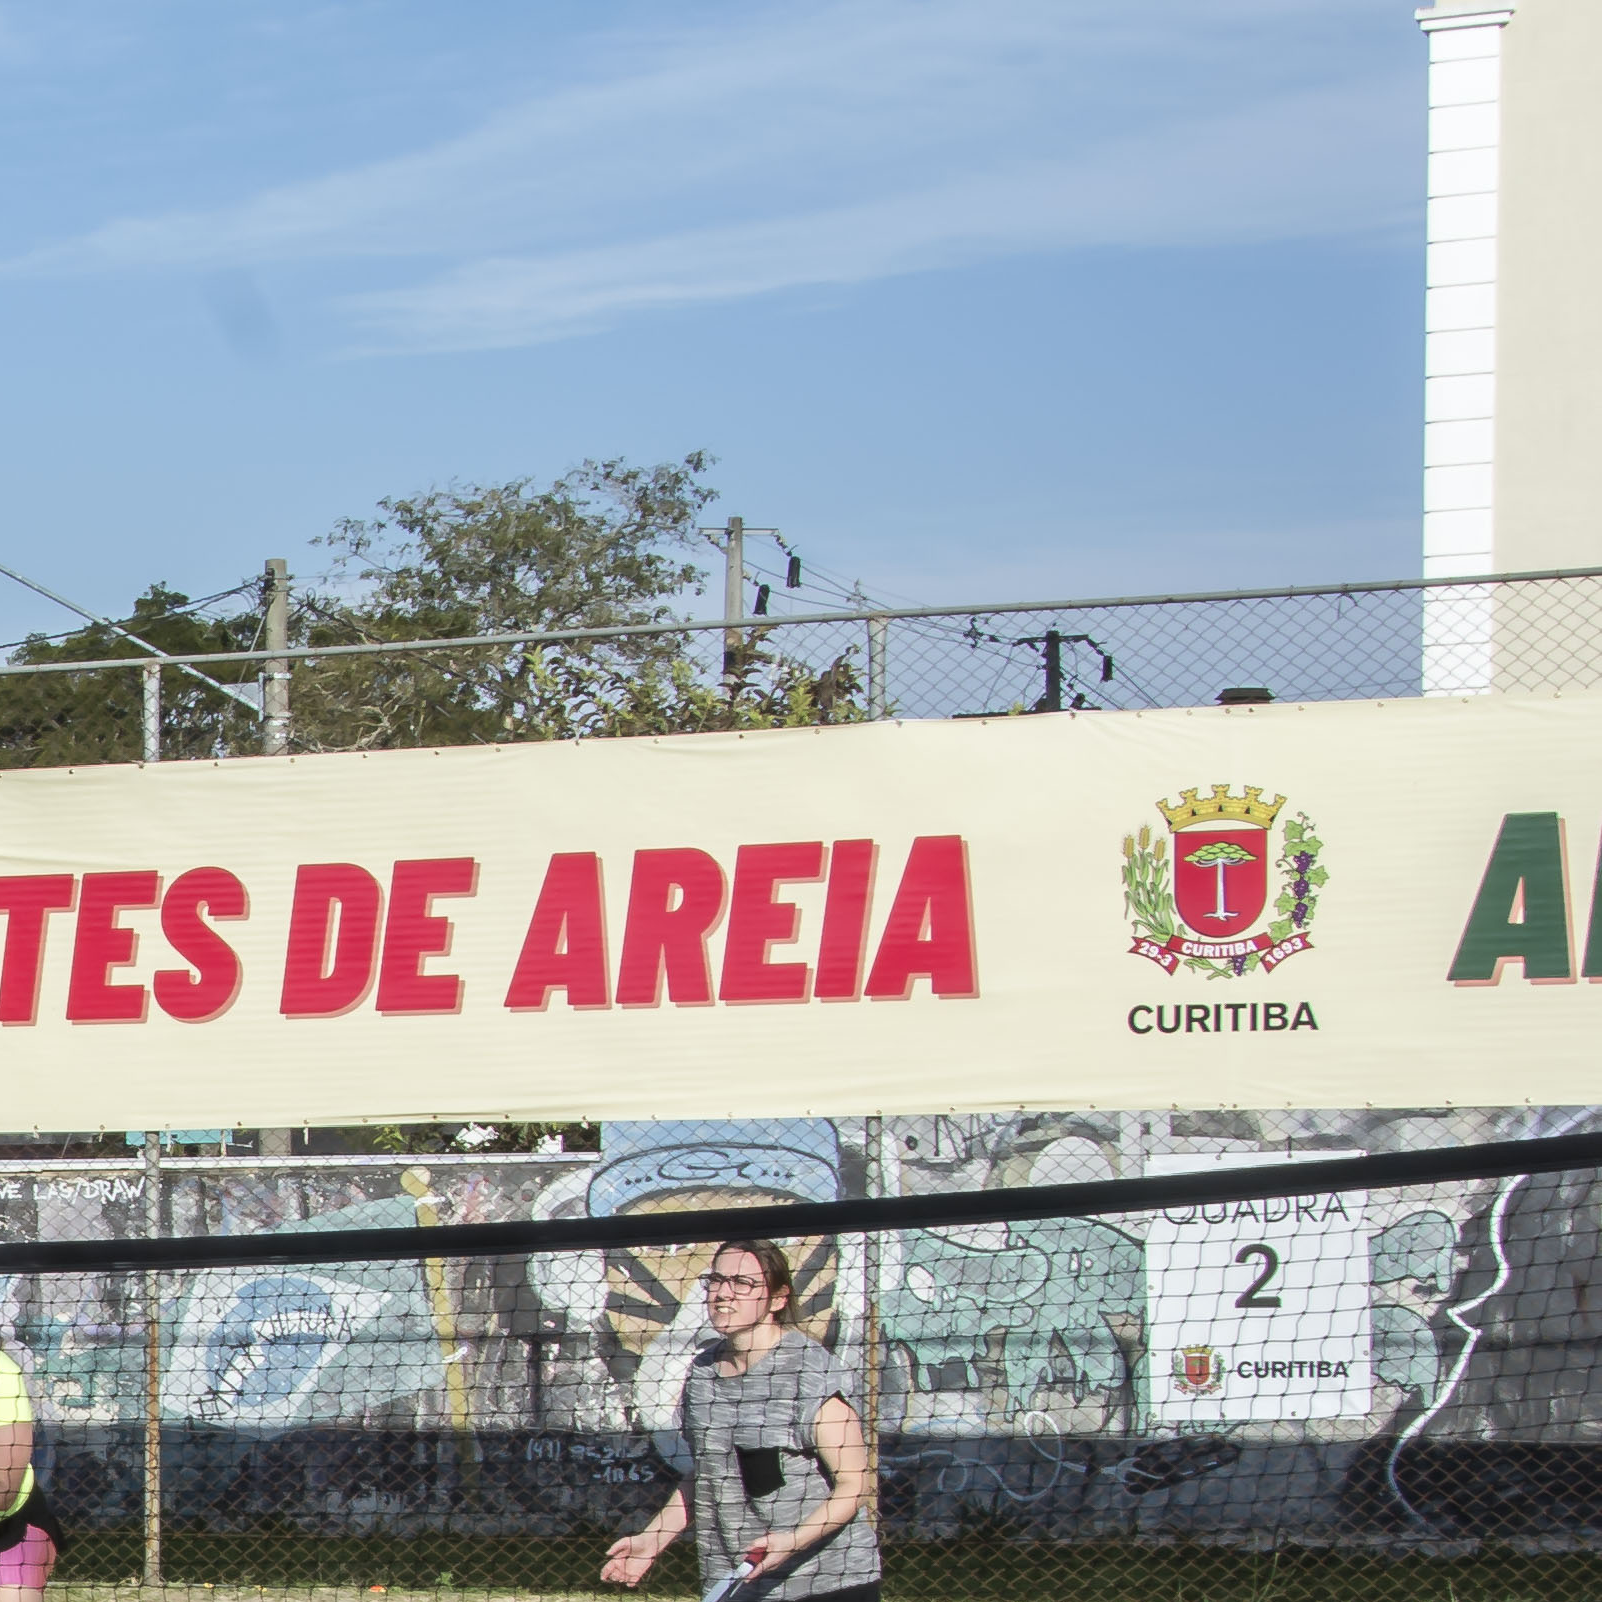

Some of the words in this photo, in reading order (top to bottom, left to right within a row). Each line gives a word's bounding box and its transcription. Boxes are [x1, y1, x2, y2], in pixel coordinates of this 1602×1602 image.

[1447, 811, 1602, 987] A
[280, 857, 478, 1019] DE
[504, 834, 982, 1012] AREIA
[1139, 941, 1173, 967] 29-3
[1181, 939, 1258, 957] CURITIBA
[1264, 937, 1304, 965] 1693
[1127, 1001, 1319, 1035] CURITIBA
[1163, 1191, 1350, 1225] QUADRA
[1235, 1243, 1282, 1308] 2
[1236, 1361, 1350, 1379] CURITIBA
